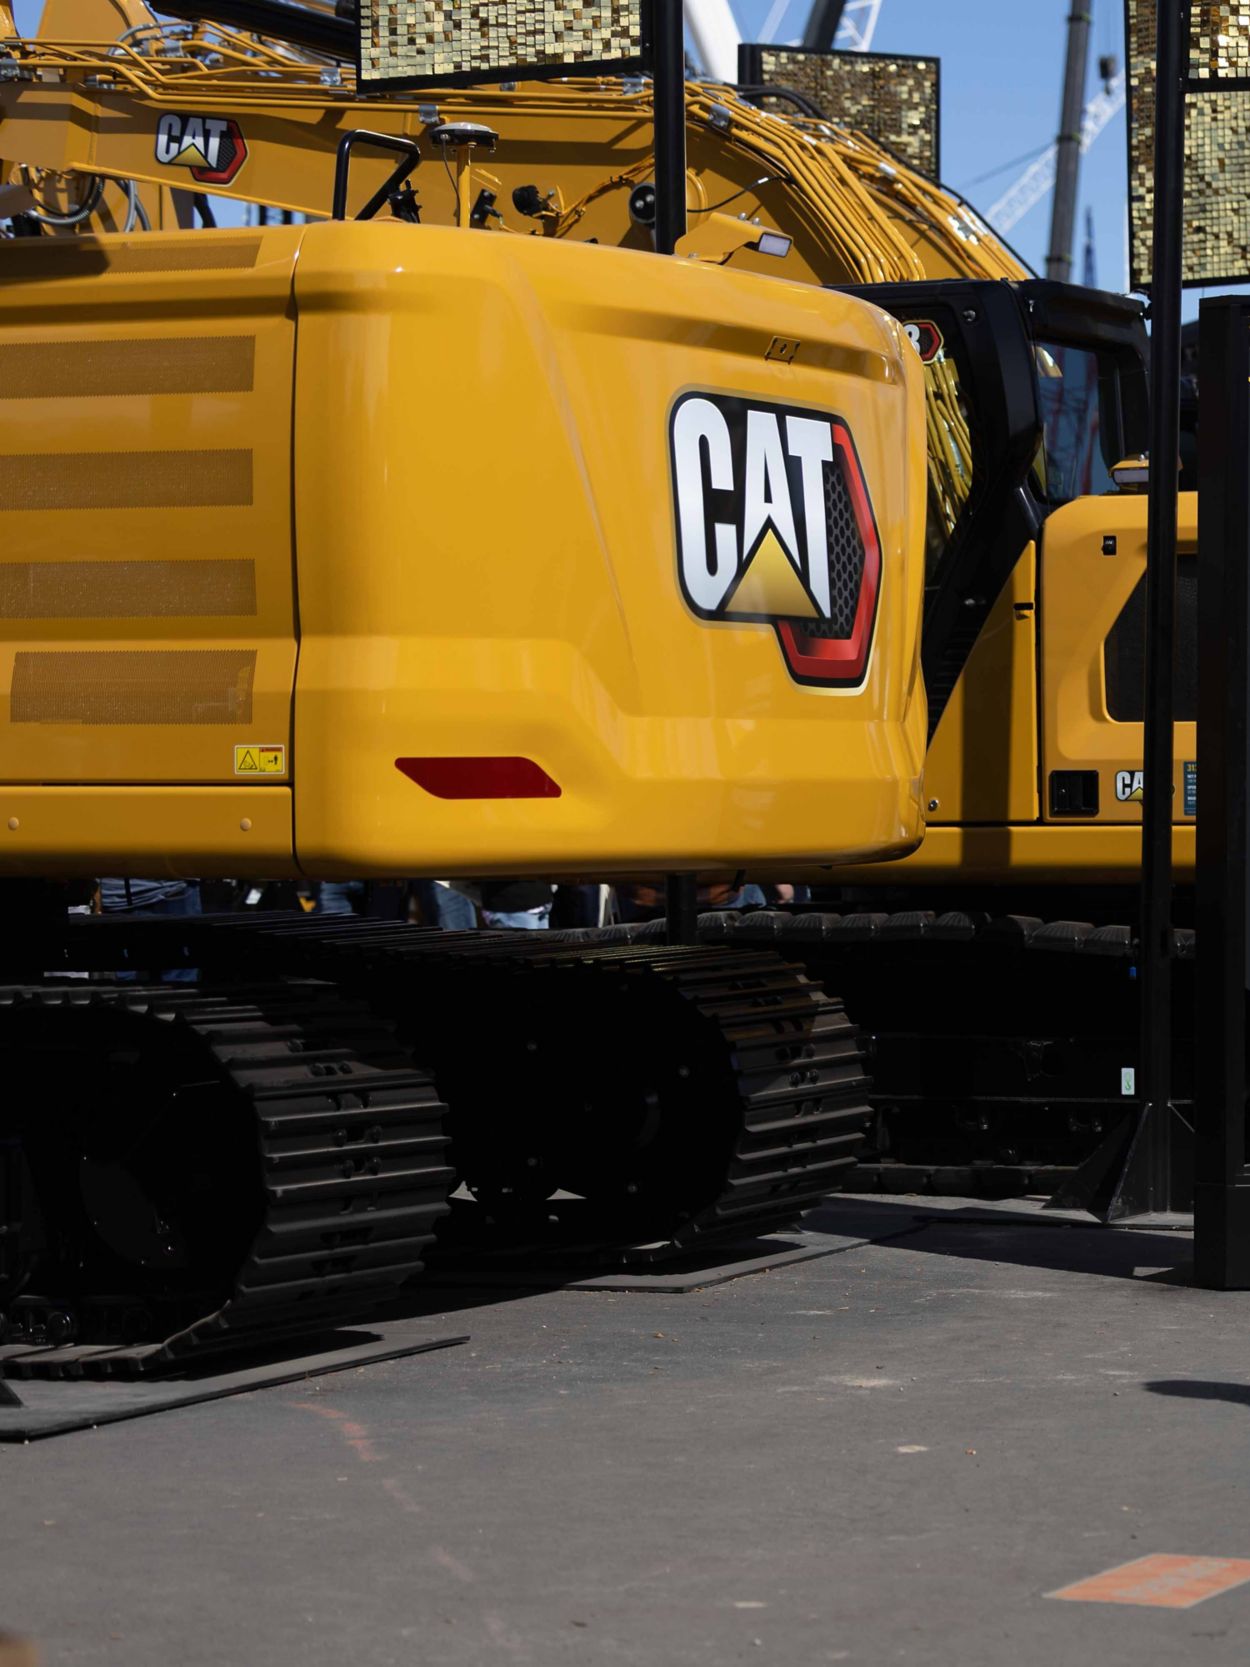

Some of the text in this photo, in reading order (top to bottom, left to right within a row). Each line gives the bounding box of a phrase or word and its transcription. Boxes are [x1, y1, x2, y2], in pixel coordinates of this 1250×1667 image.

[157, 114, 228, 168] CAT
[673, 398, 834, 618] CAT
[1117, 771, 1144, 800] CA
